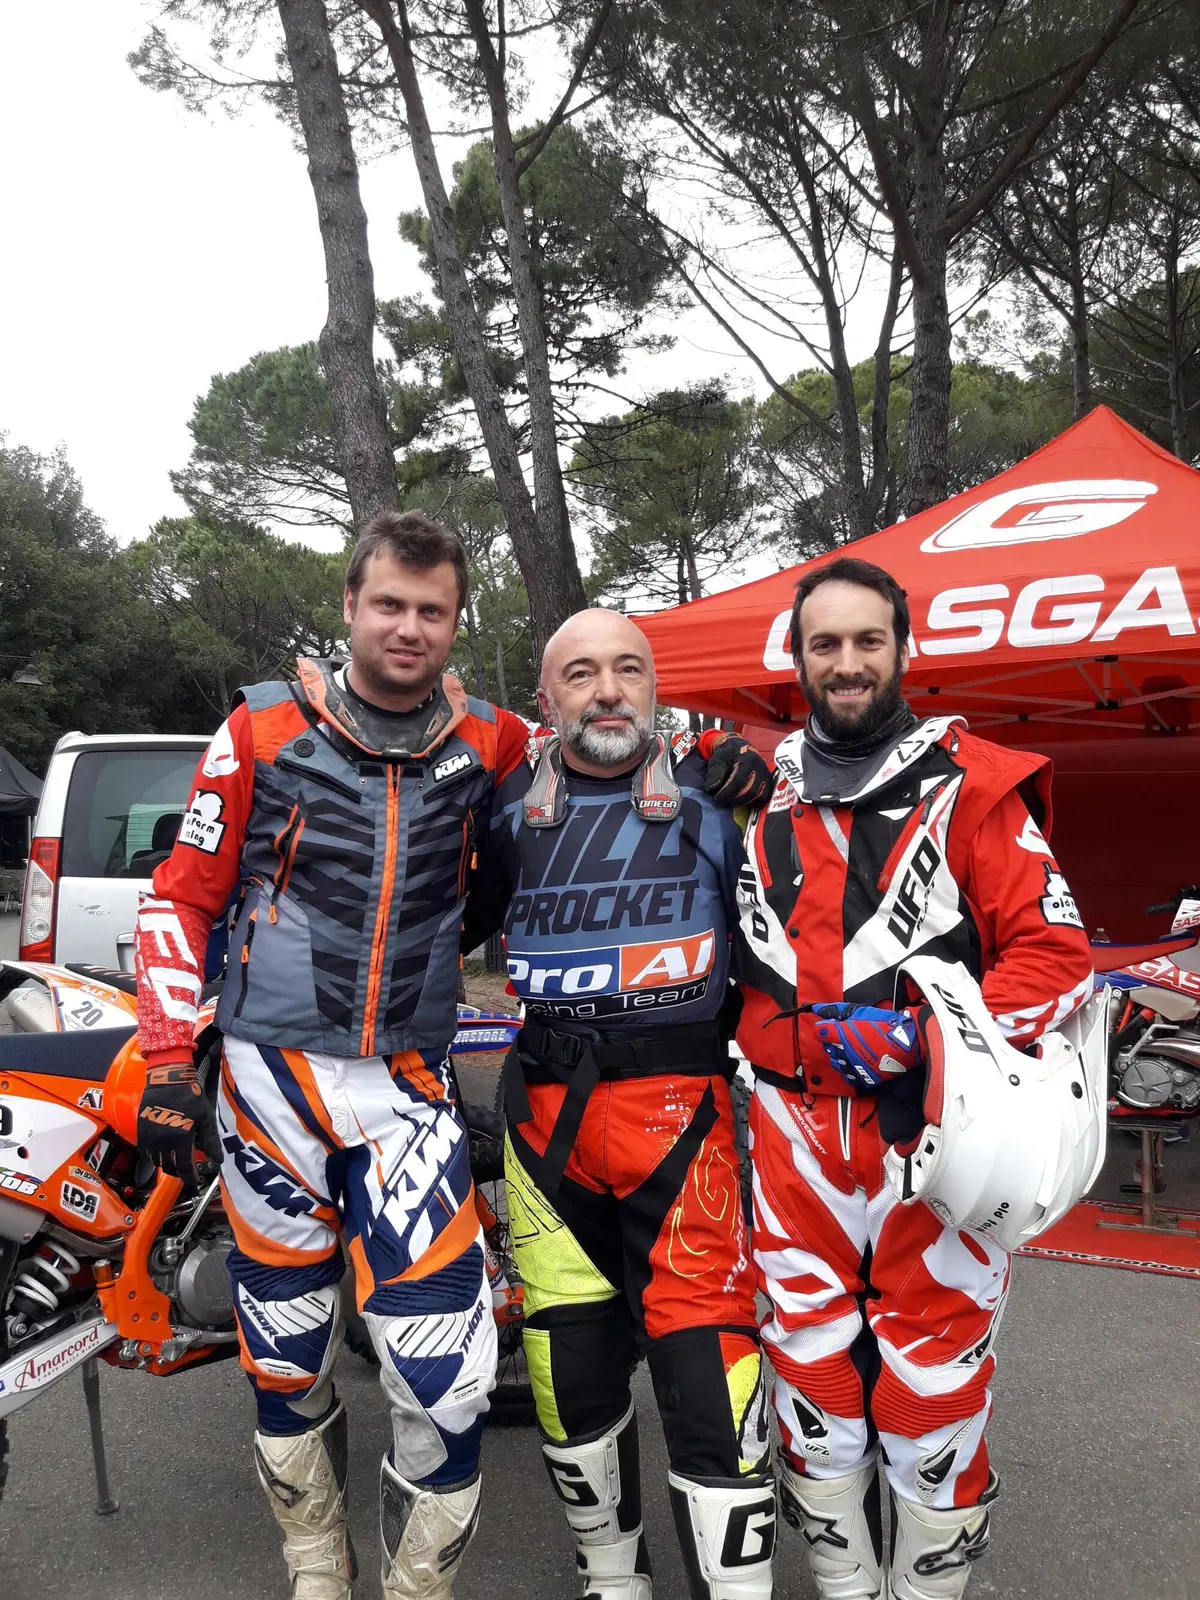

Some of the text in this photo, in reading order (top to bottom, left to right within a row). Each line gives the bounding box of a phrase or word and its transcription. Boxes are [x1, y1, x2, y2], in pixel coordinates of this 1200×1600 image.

[434, 753, 471, 780] KTM
[526, 804, 553, 819] X1
[639, 799, 678, 809] OMEGA
[887, 835, 941, 949] UFO
[611, 981, 706, 1009] Team
[71, 1001, 104, 1027] 20
[140, 1106, 194, 1132] KTM
[222, 1134, 317, 1219] KTM
[382, 1110, 464, 1238] KTM
[15, 1325, 99, 1391] Amarcord
[805, 1442, 830, 1456] UFO
